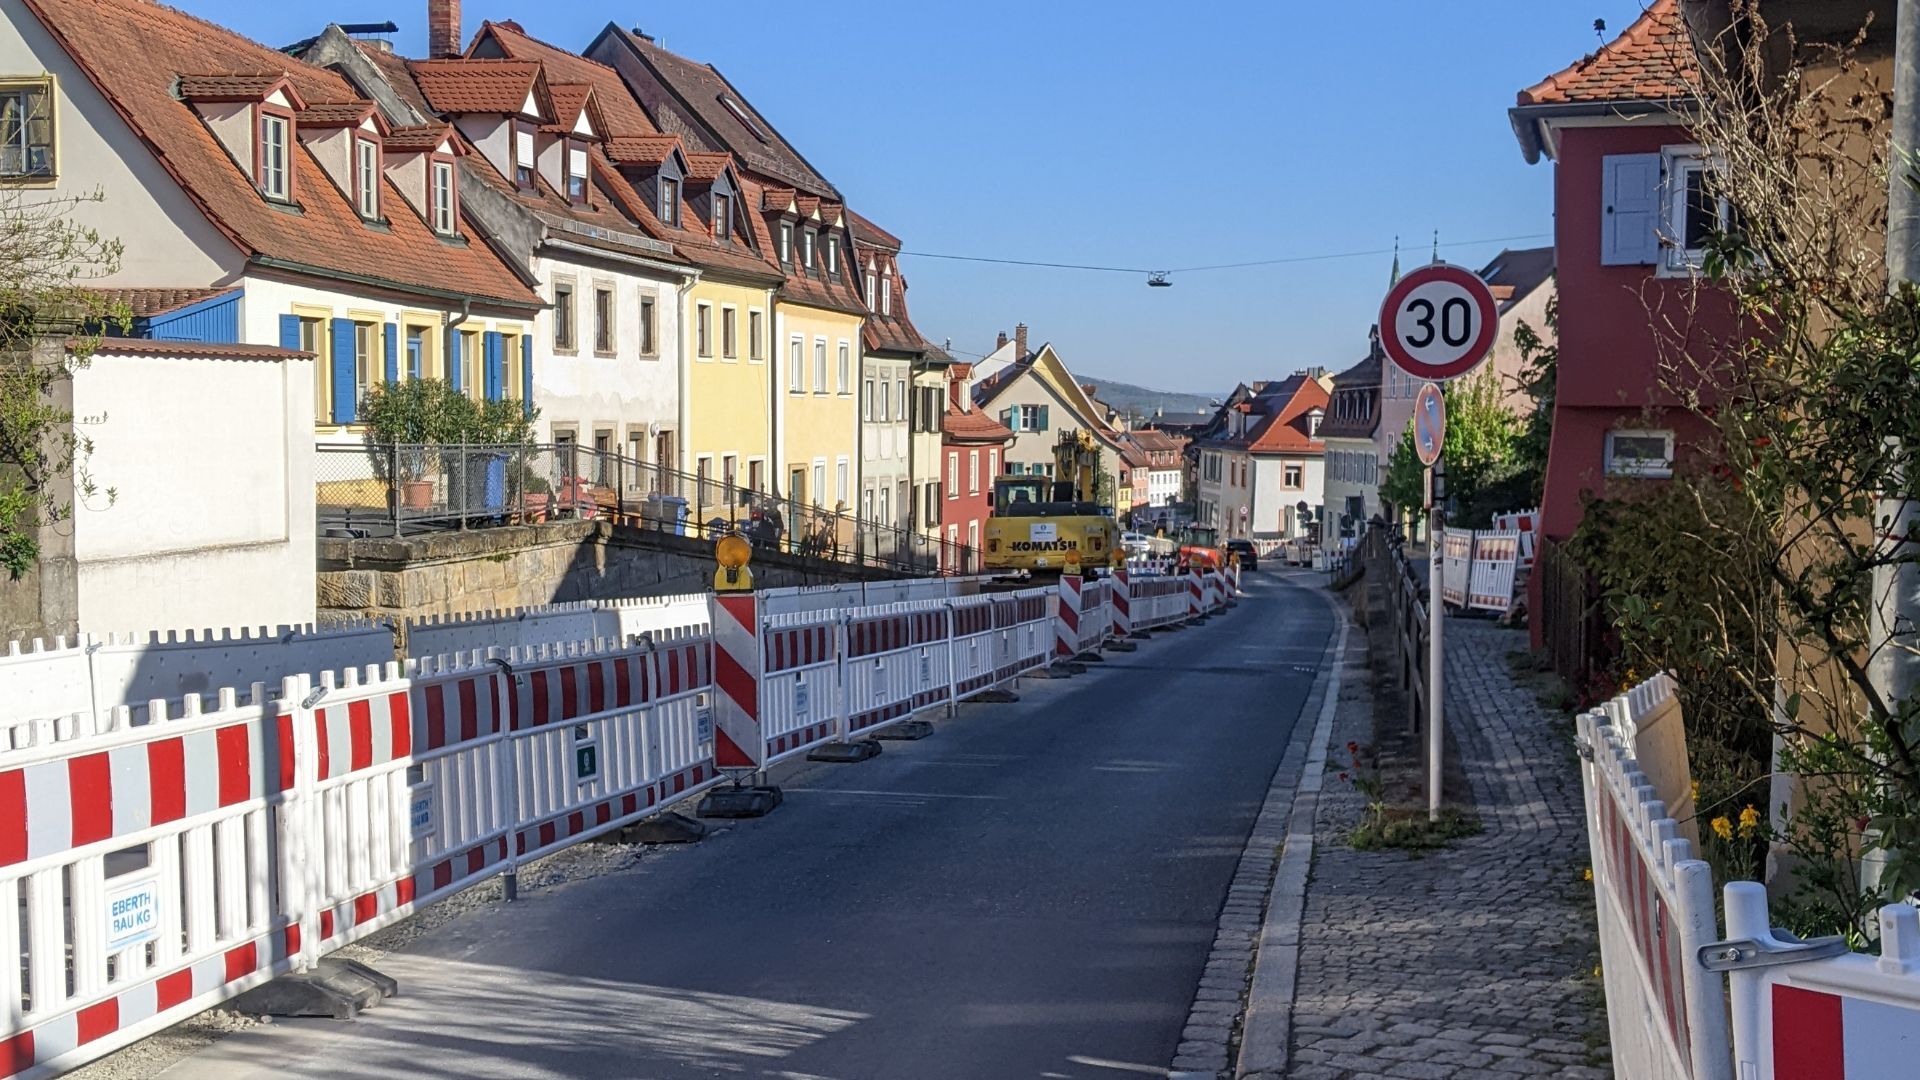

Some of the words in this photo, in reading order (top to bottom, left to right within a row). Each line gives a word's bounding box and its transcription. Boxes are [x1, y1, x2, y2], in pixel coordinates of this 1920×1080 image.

[1406, 297, 1471, 348] 30
[1012, 537, 1077, 551] KOMATSU
[112, 891, 151, 917] EBERTH
[113, 913, 134, 933] BAU
[136, 908, 151, 926] KG
